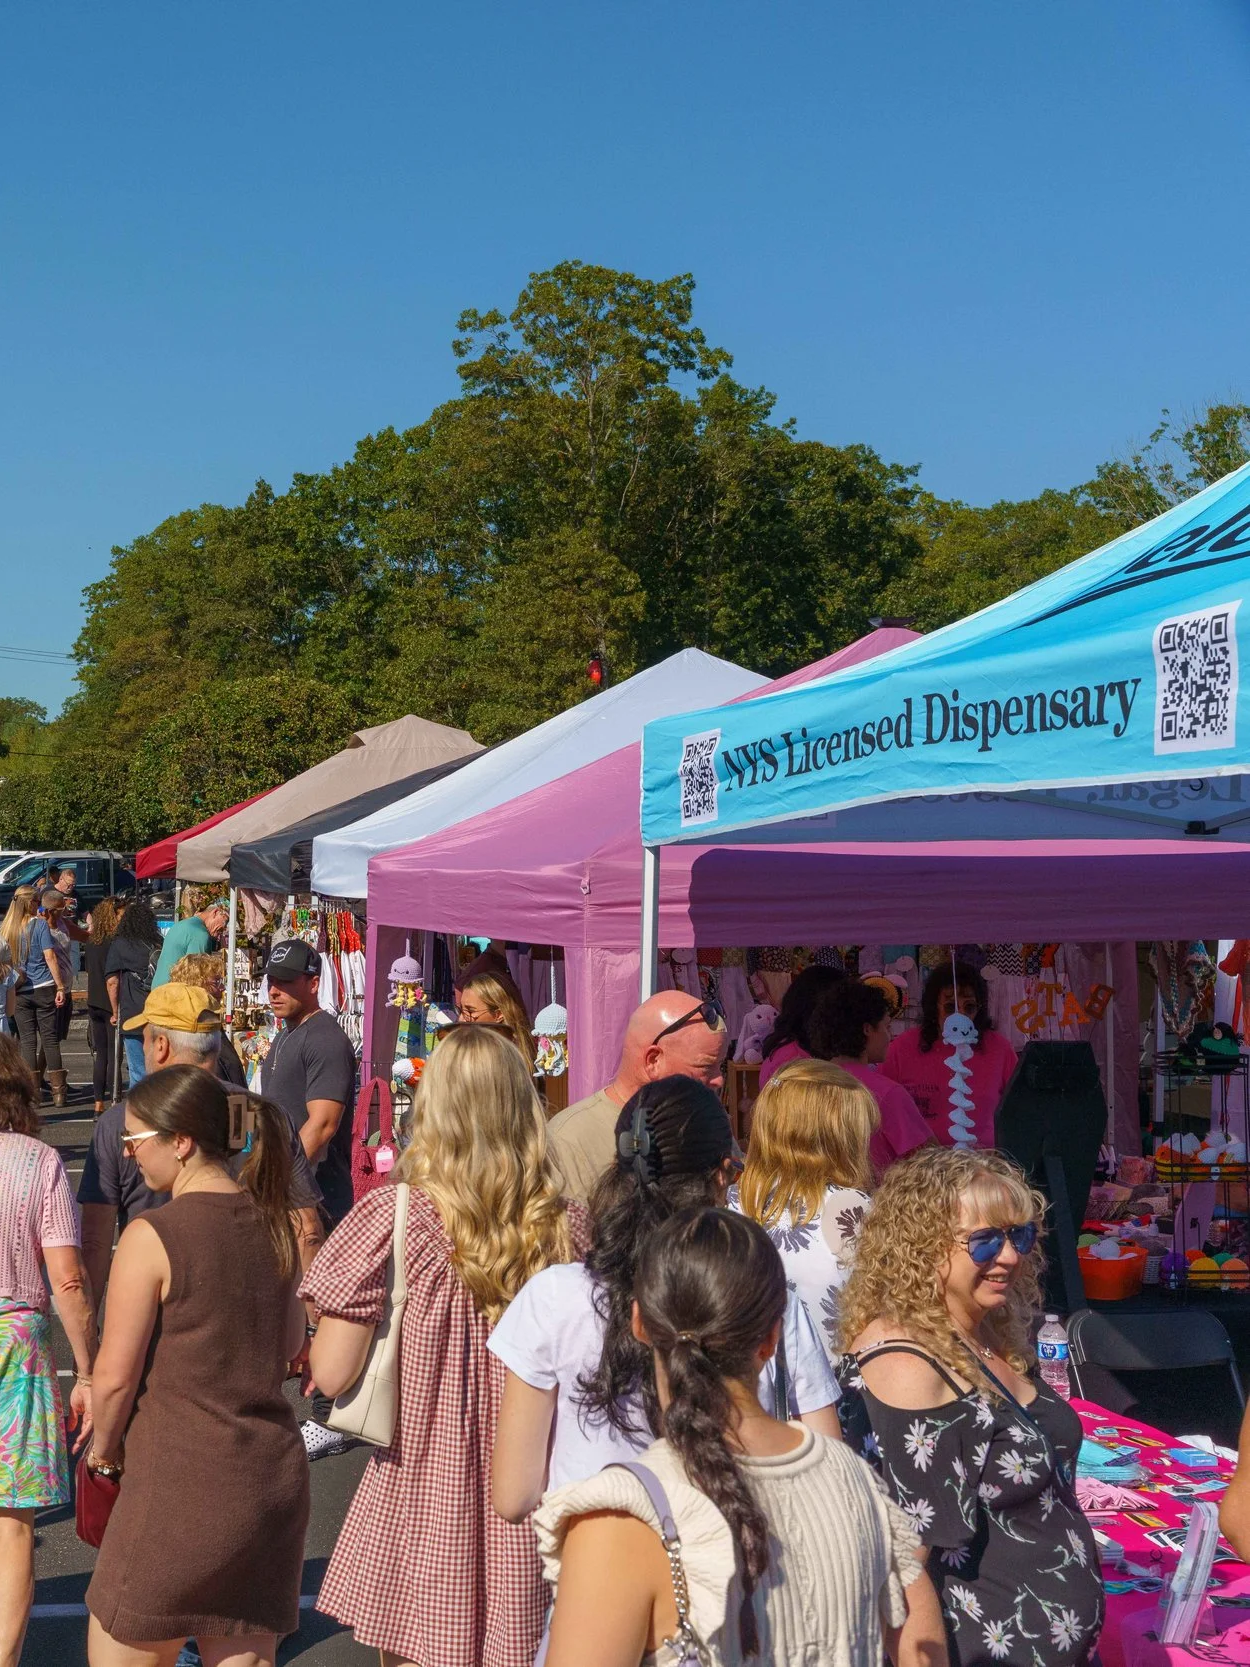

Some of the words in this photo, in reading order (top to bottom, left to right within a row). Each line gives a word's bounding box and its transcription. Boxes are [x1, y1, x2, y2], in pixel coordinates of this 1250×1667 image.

[721, 736, 779, 793] NYS
[780, 697, 915, 778] Licensed
[922, 677, 1142, 753] Dispensary
